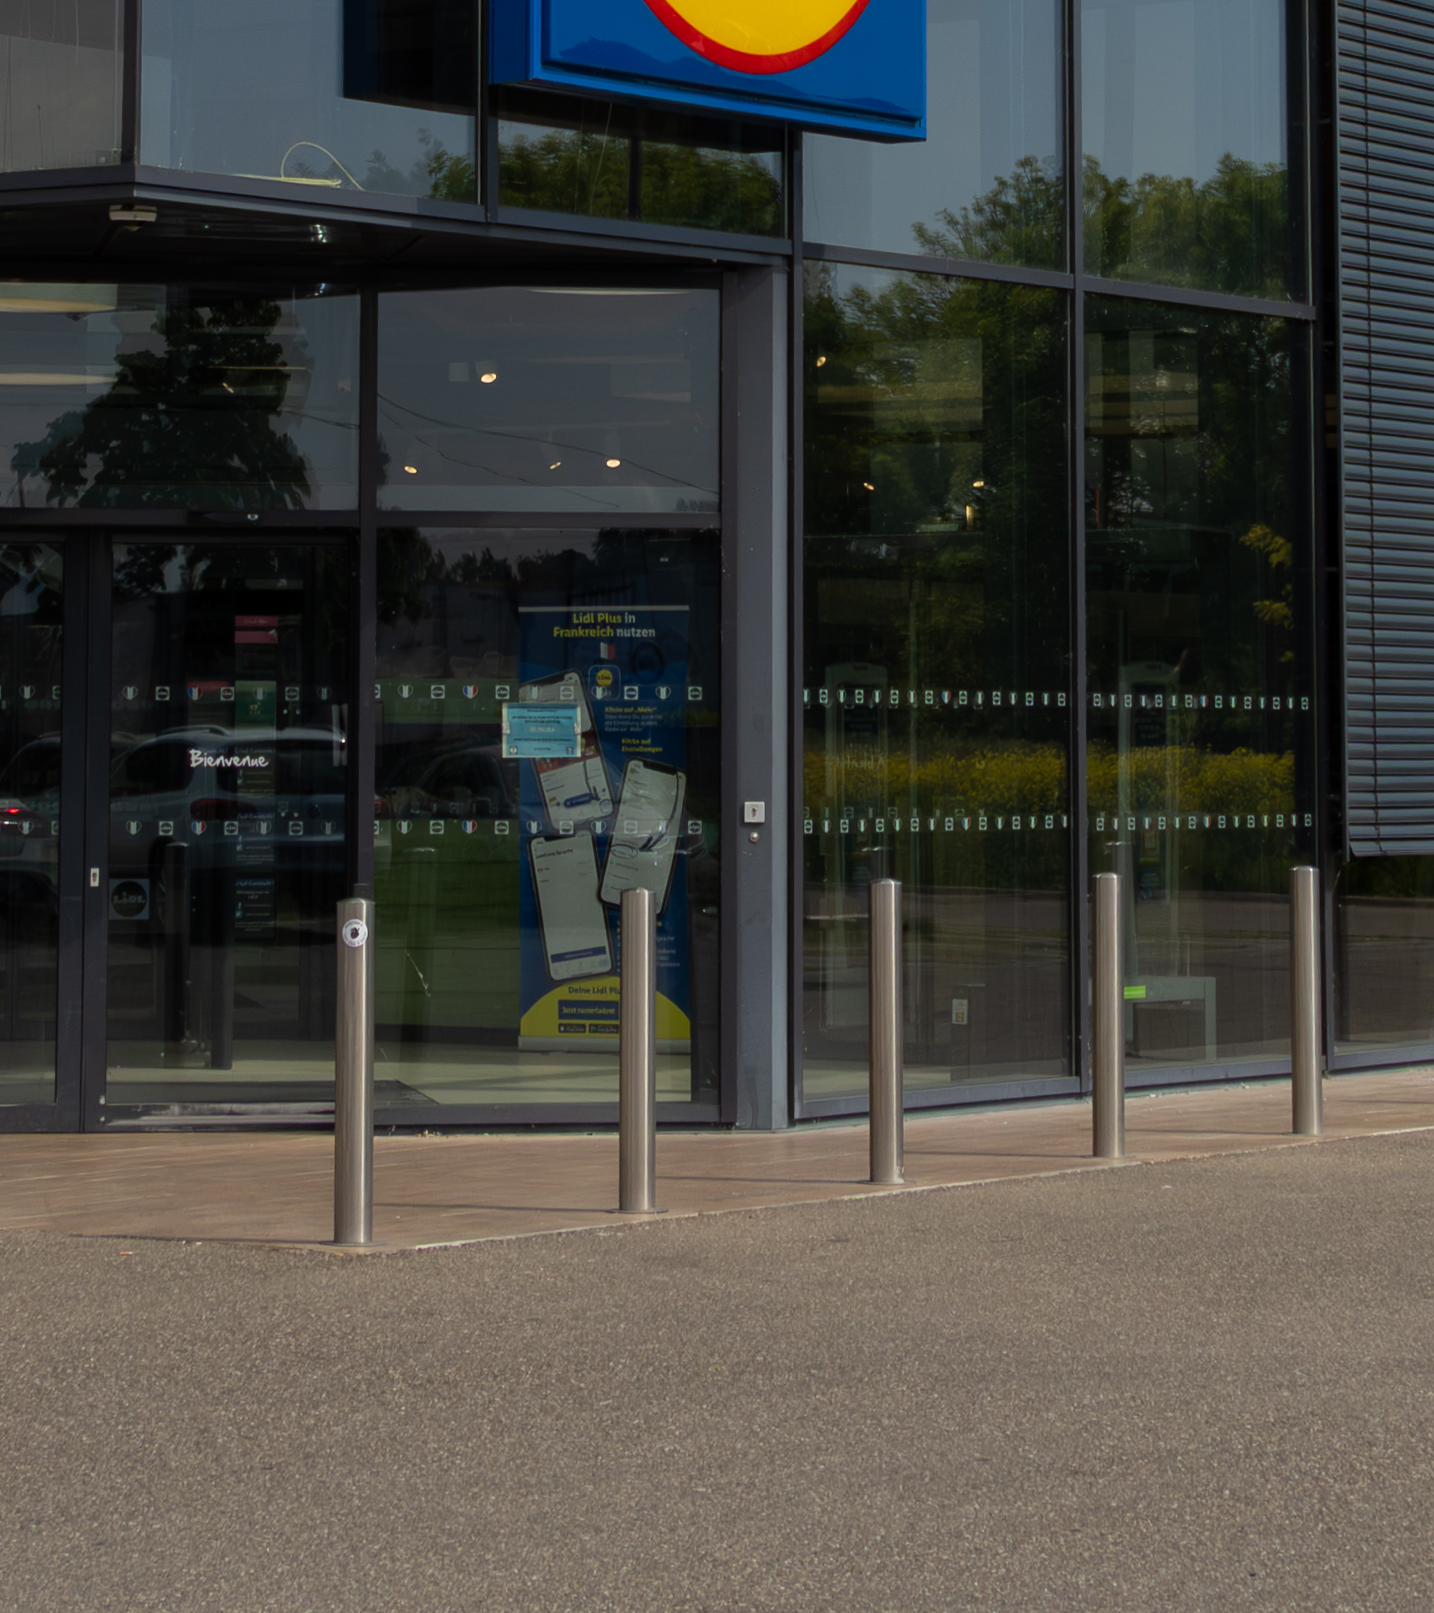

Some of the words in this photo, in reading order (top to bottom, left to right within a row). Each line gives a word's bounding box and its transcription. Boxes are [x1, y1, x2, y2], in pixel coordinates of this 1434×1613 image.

[573, 612, 595, 624] Lidl
[597, 613, 622, 625] Plus
[624, 612, 636, 624] in
[553, 625, 614, 638] Frankreich
[616, 627, 656, 638] nutzen
[189, 748, 269, 768] Bienvenue
